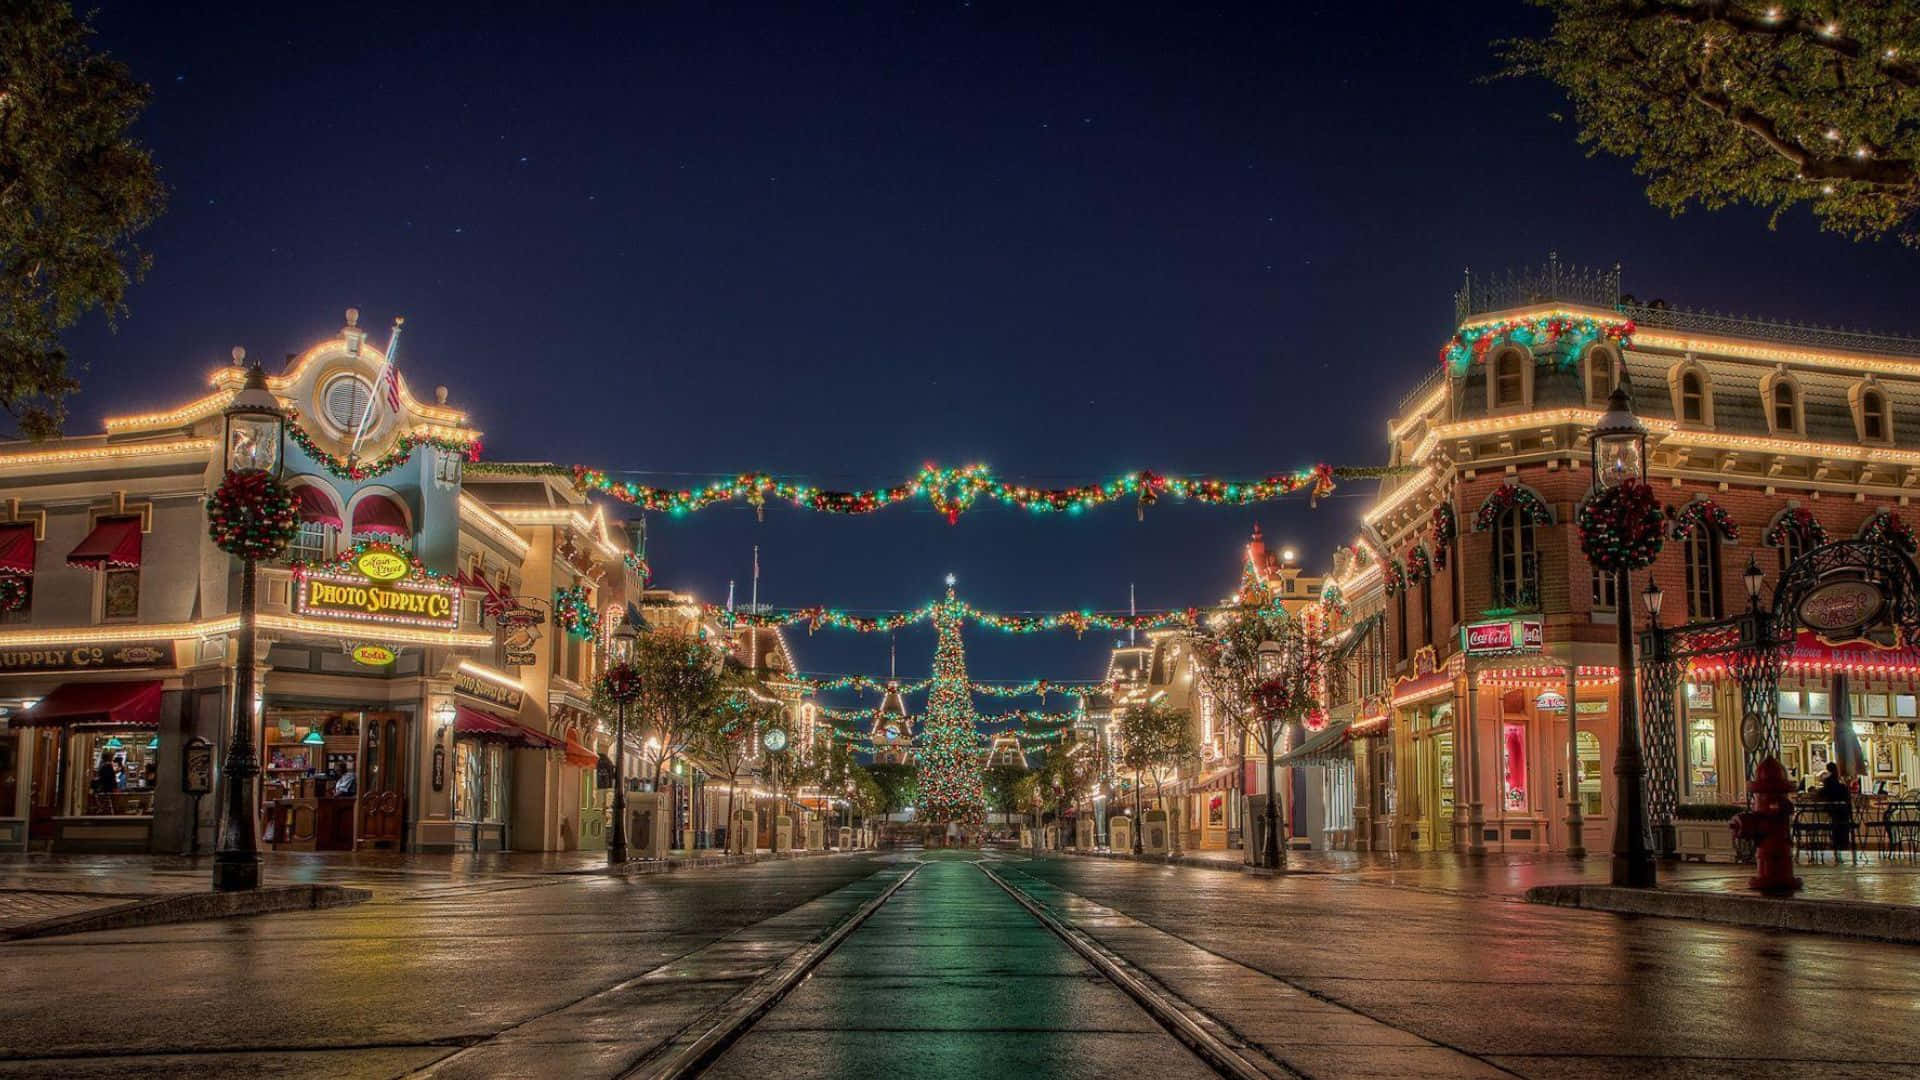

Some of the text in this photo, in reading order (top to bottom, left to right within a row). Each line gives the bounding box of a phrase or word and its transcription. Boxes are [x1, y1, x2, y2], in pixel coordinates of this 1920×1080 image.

[310, 581, 367, 606] PHOTO
[367, 587, 429, 612] SUPPLY
[0, 649, 67, 666] UPPLY
[361, 649, 387, 660] Kodak
